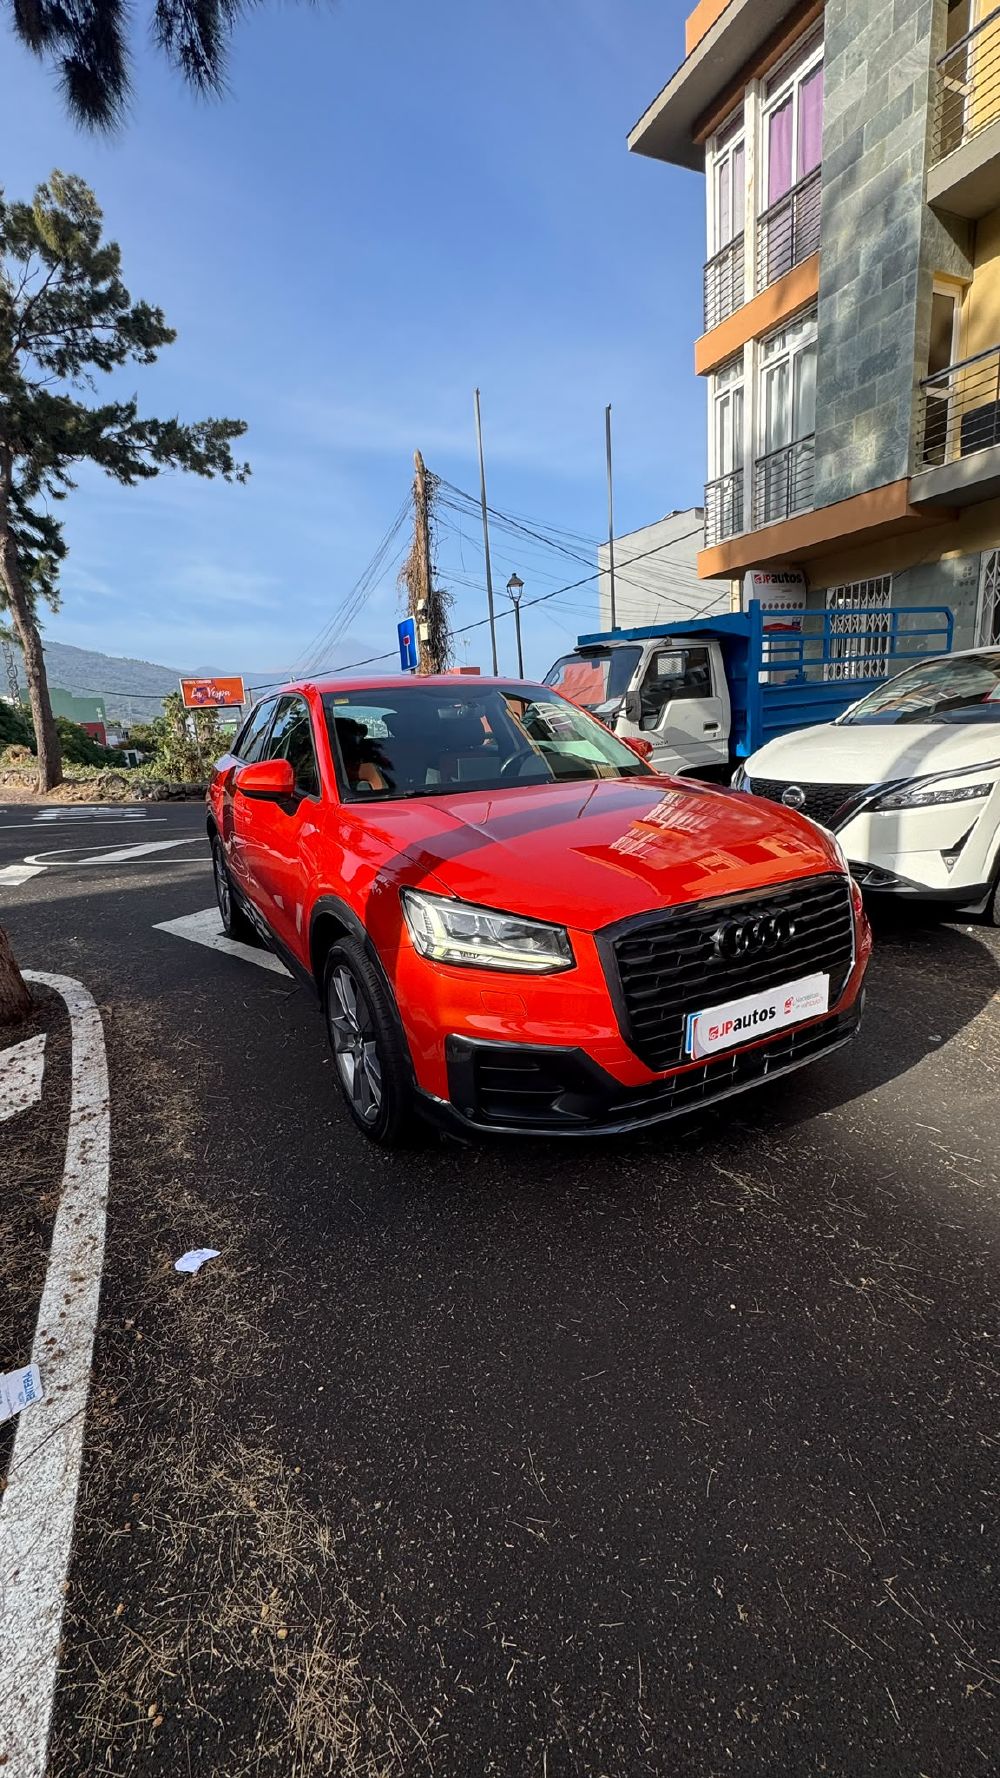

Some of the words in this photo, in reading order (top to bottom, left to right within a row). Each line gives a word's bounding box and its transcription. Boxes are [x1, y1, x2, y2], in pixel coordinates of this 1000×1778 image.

[191, 687, 203, 699] La
[207, 687, 231, 699] Vespa
[720, 1005, 776, 1037] JPautos
